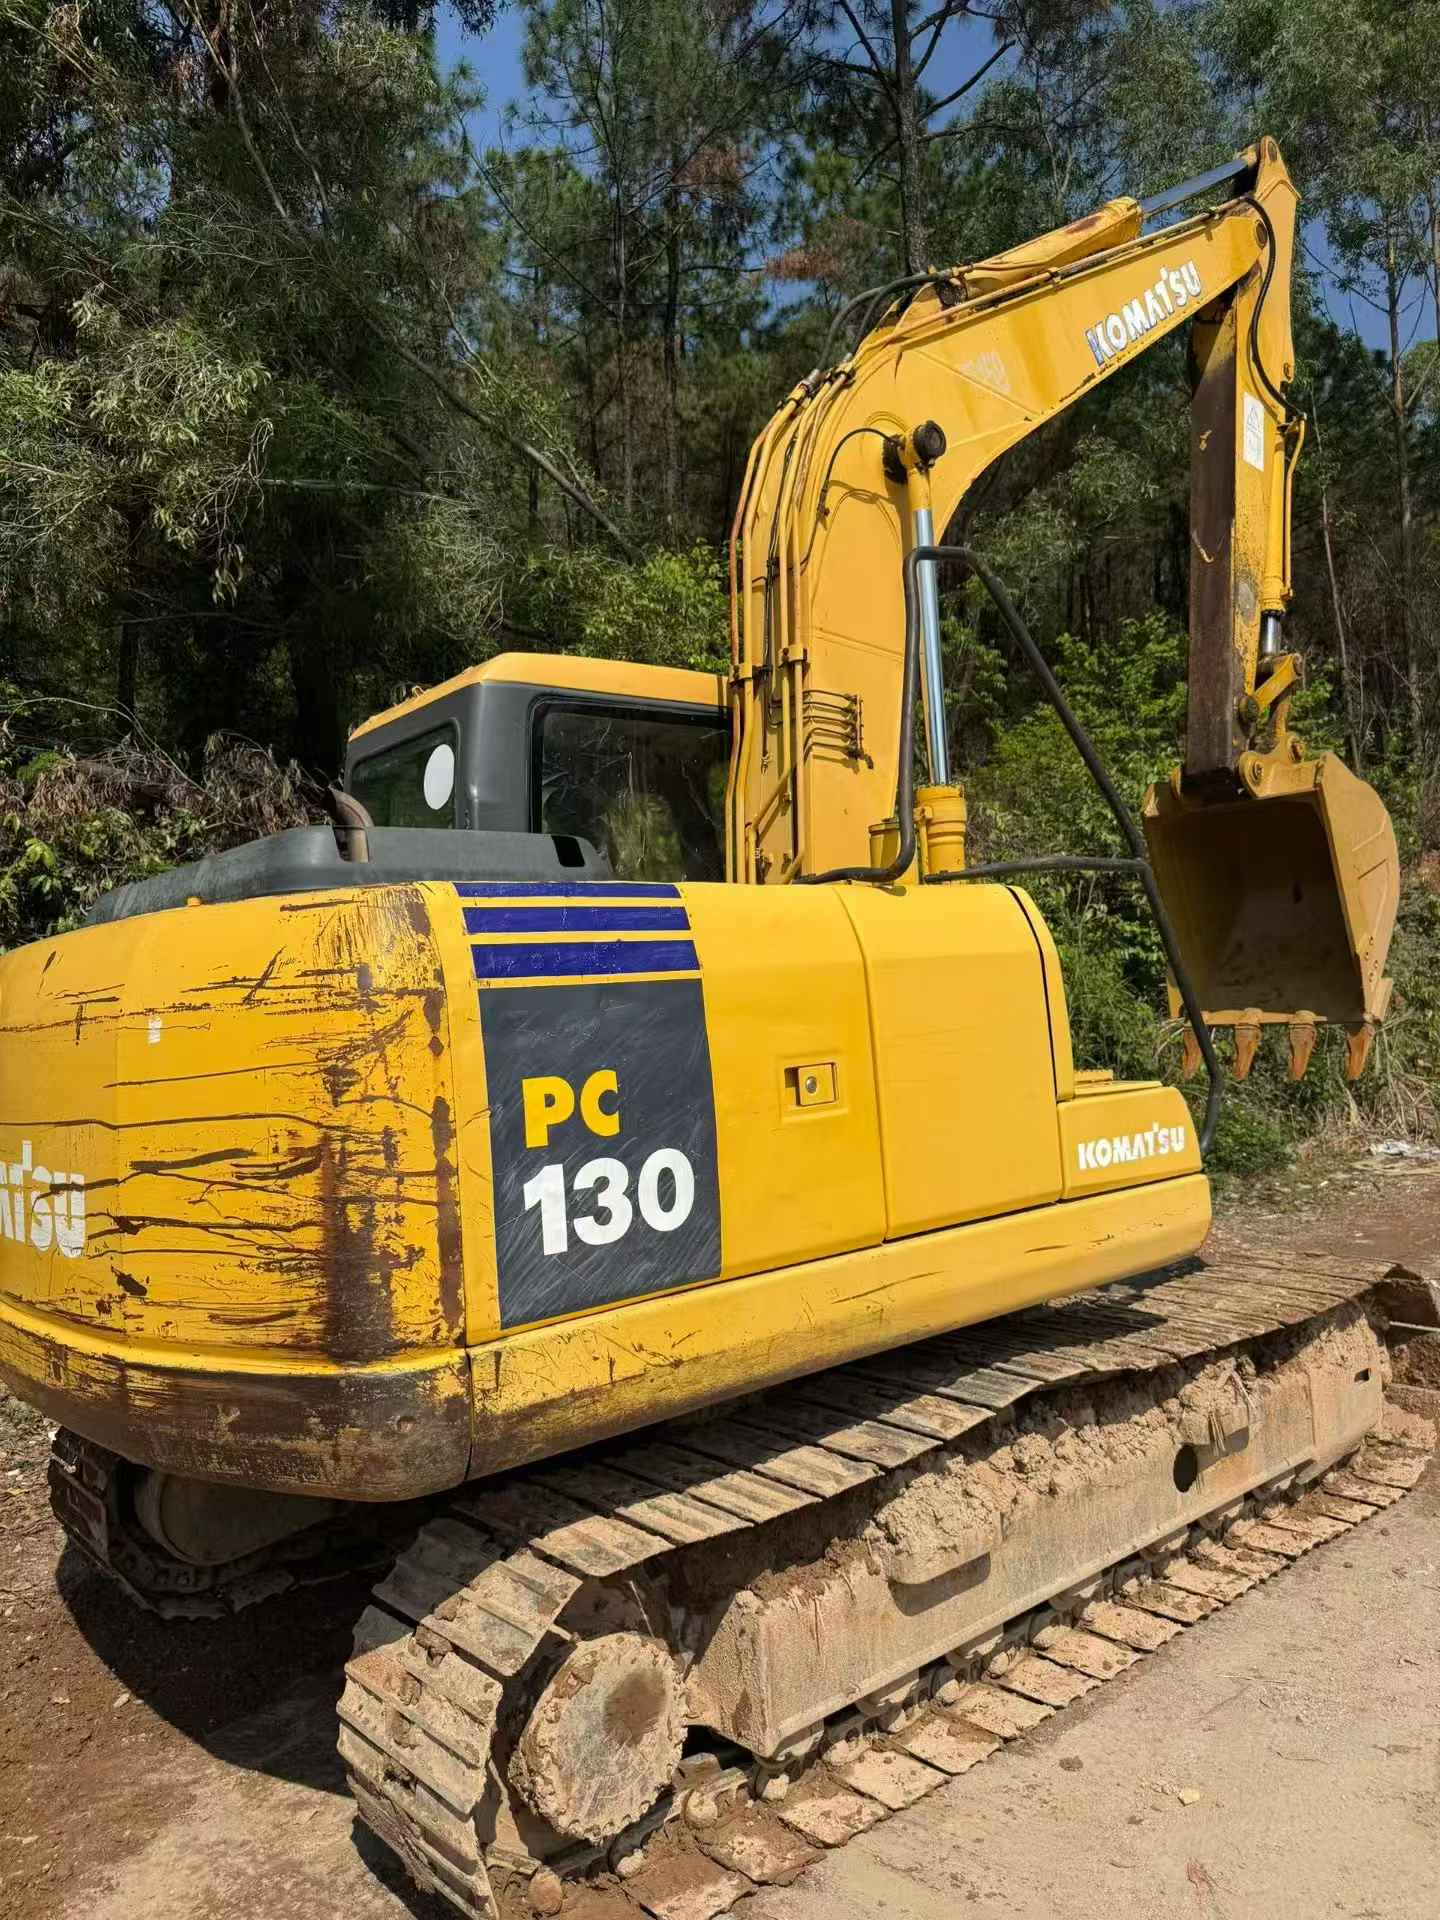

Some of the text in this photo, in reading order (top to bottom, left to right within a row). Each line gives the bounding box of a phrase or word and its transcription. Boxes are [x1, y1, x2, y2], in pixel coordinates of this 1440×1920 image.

[1086, 261, 1201, 366] KOMATSU
[522, 1069, 621, 1149] PC
[1078, 1121, 1186, 1170] KOMATSU
[523, 1147, 695, 1256] 130
